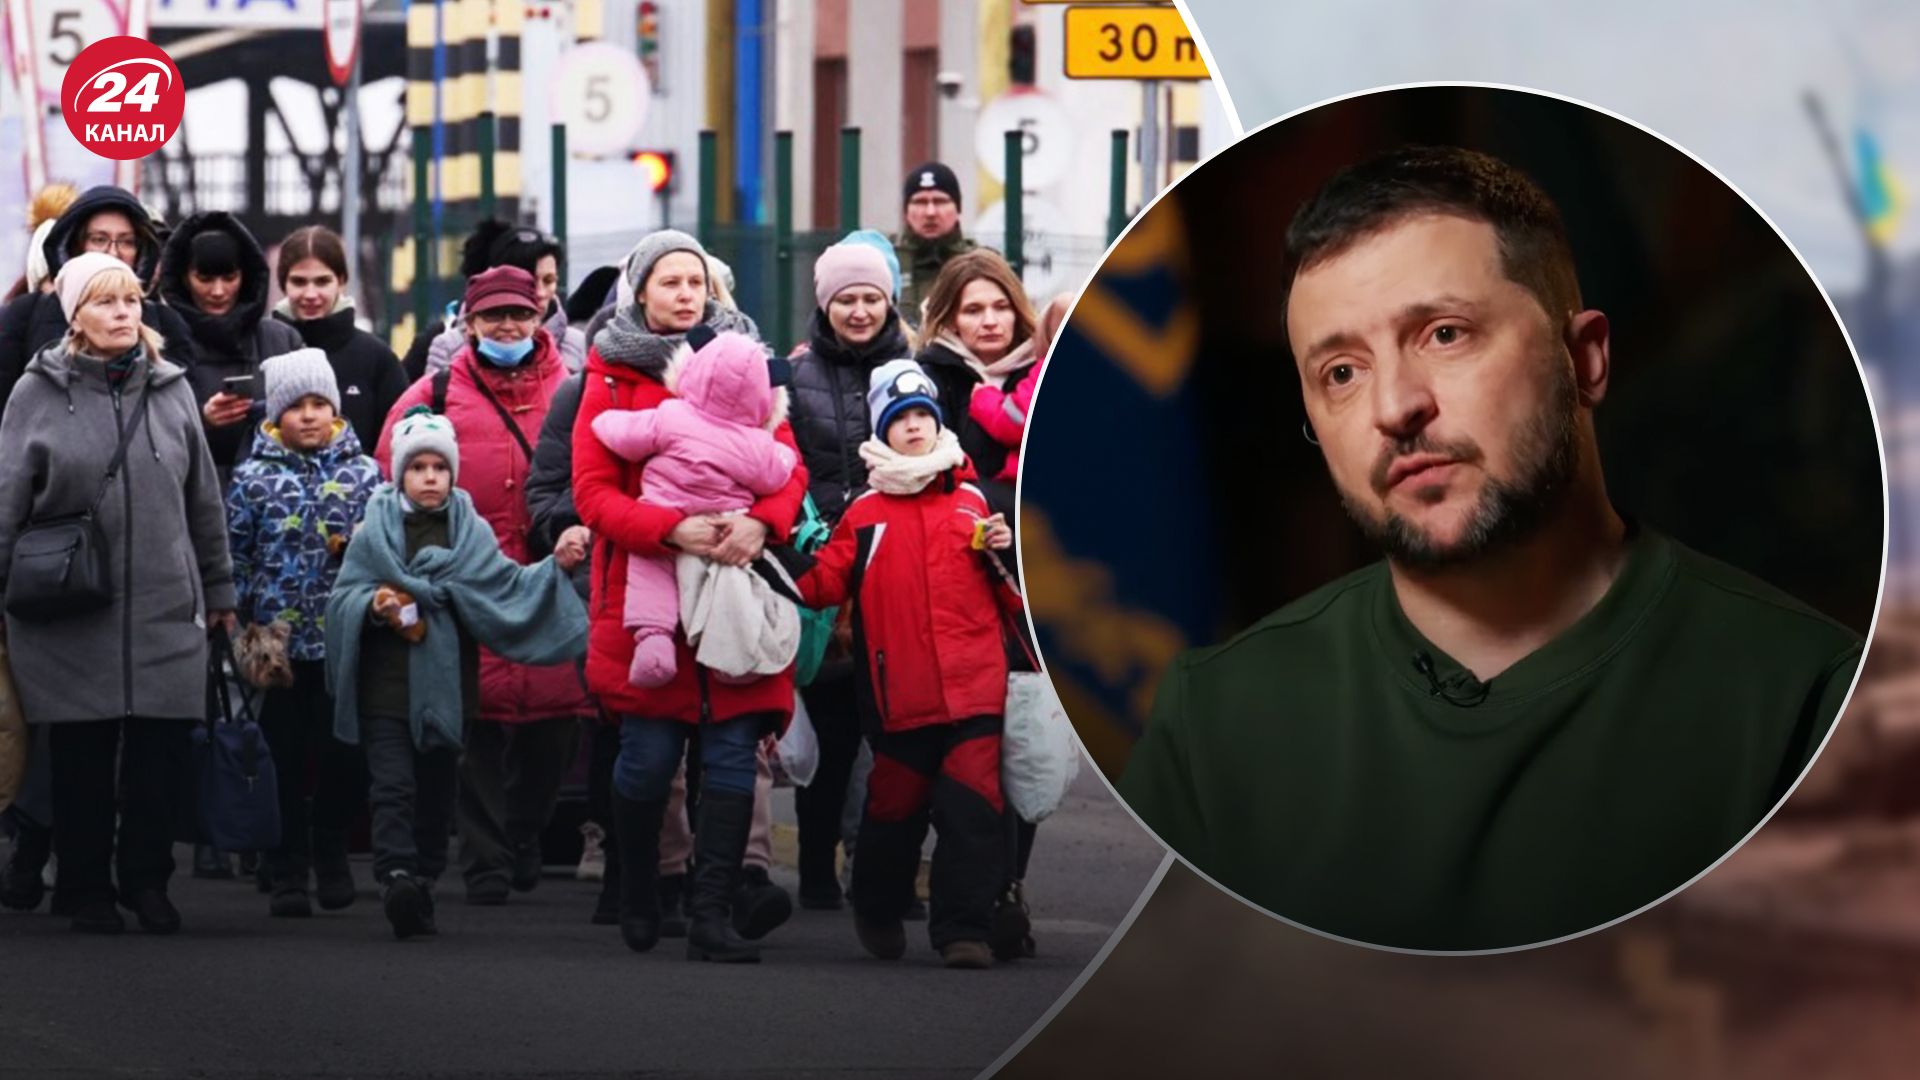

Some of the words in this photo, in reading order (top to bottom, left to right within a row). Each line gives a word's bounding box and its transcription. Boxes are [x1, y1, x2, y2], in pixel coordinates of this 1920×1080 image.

[49, 11, 83, 67] 5
[1099, 23, 1157, 62] 30
[584, 76, 611, 122] 5
[1018, 118, 1039, 155] 5
